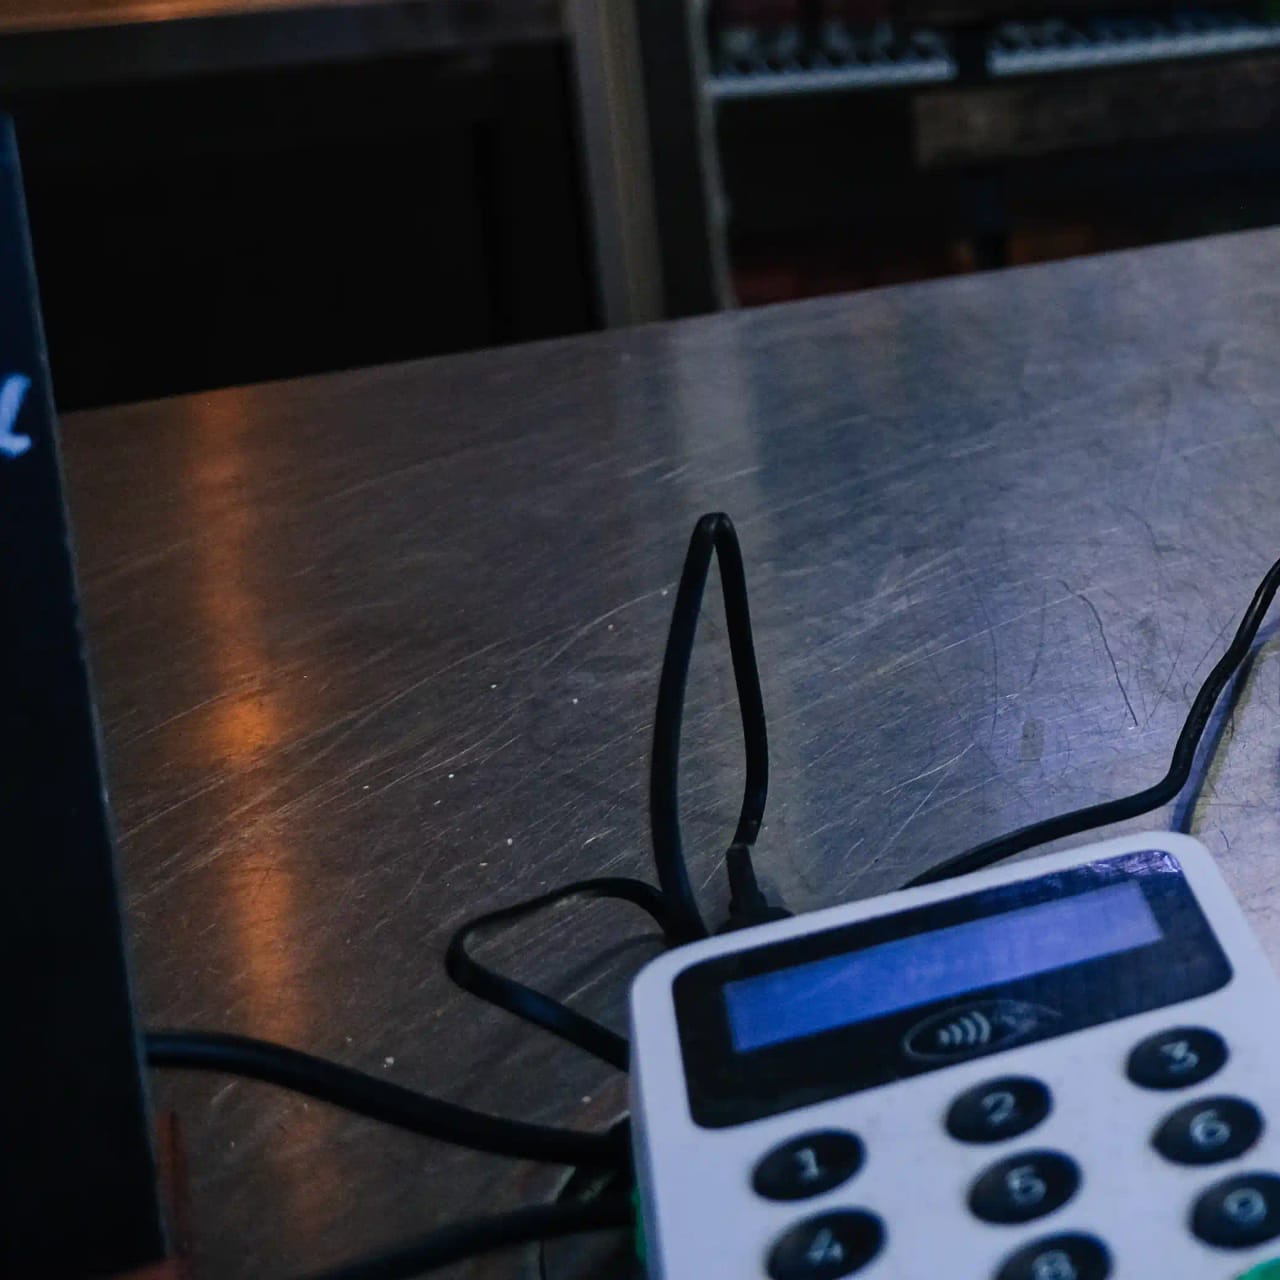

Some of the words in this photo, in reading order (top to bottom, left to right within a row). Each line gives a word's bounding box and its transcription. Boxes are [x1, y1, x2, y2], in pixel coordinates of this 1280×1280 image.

[797, 1148, 819, 1181] 1
[981, 1090, 1016, 1124] 2
[1159, 1040, 1199, 1072] 3
[808, 1227, 844, 1266] 4
[1006, 1166, 1047, 1204] 5
[1189, 1109, 1231, 1146] 6
[1222, 1187, 1267, 1226] 9
